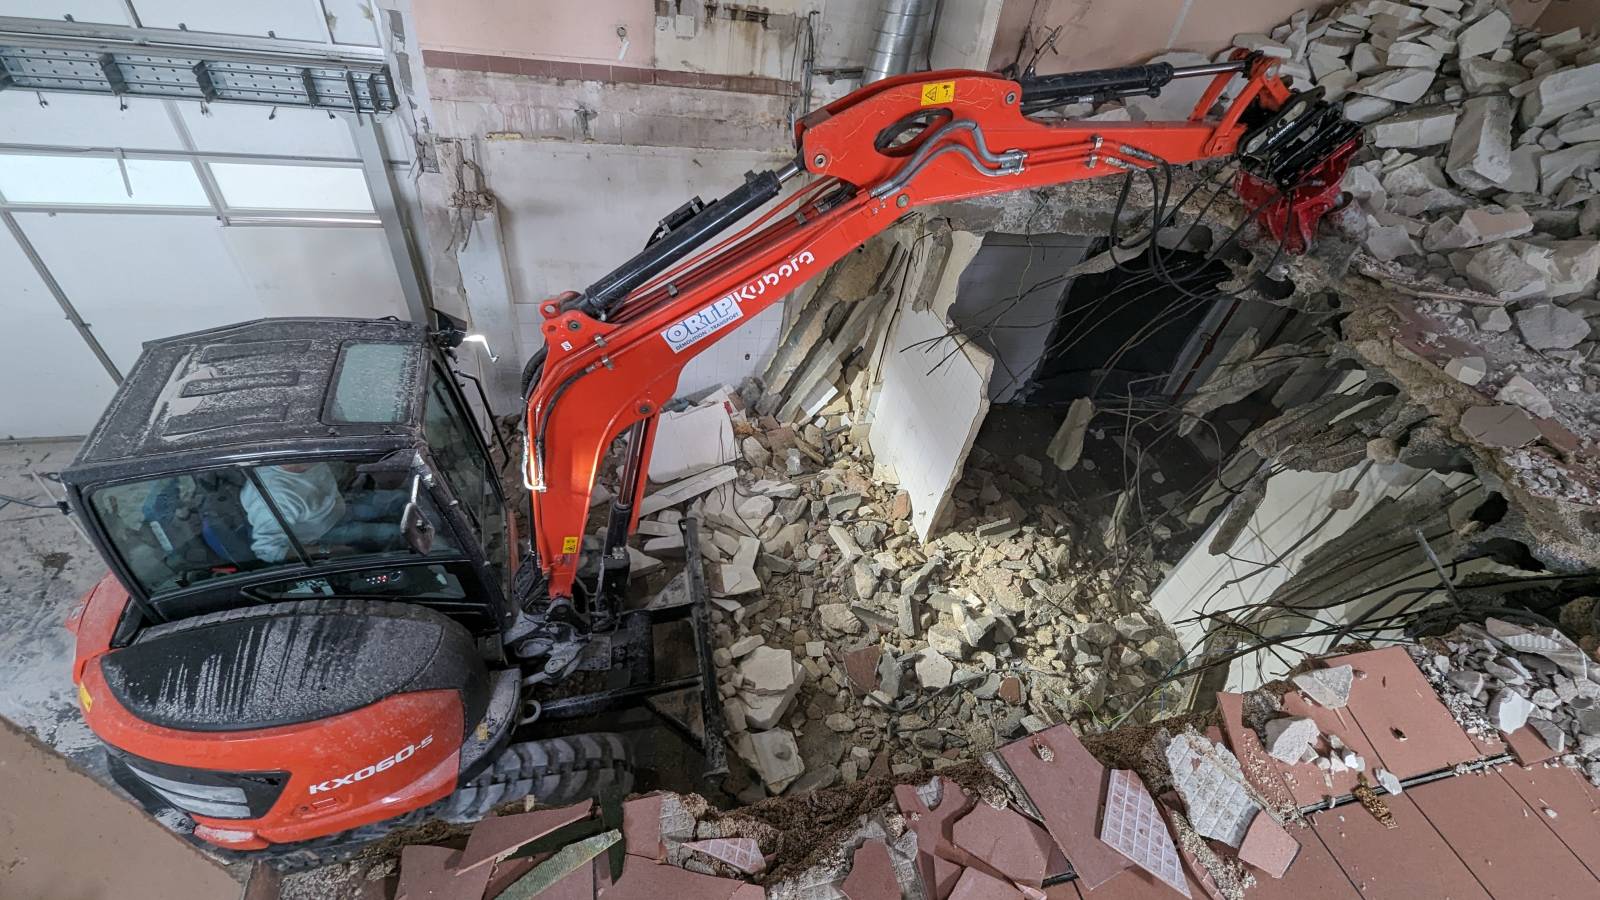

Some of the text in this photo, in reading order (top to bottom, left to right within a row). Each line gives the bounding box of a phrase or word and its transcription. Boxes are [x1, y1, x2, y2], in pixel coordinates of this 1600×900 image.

[733, 251, 814, 302] Kubota
[666, 297, 732, 342] ORTP
[710, 312, 739, 331] TRANSPORT
